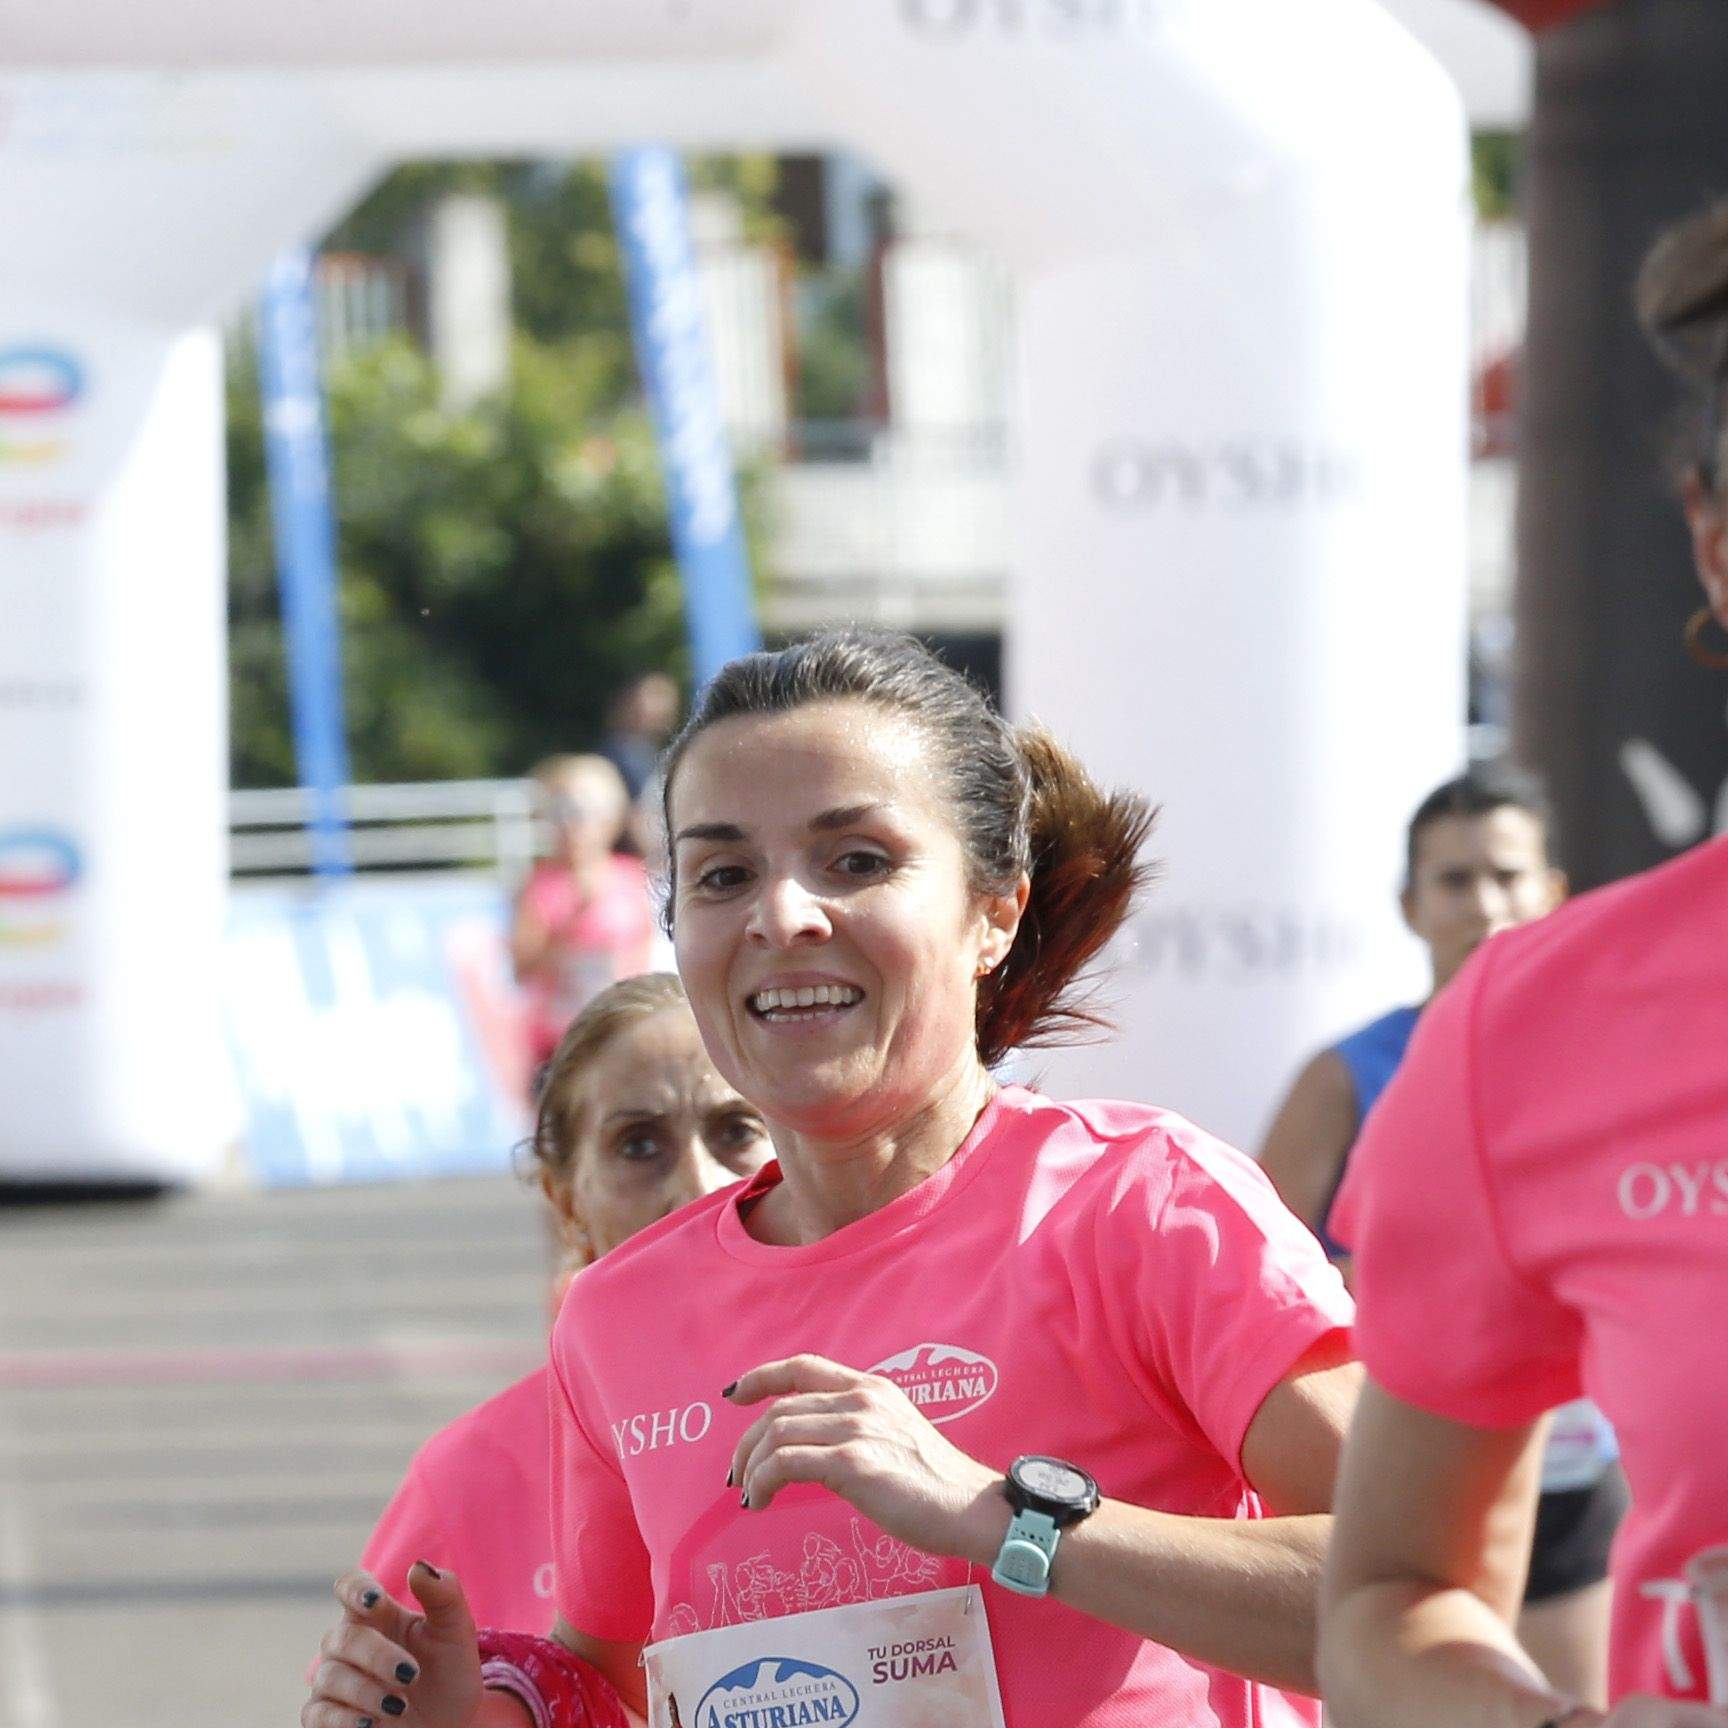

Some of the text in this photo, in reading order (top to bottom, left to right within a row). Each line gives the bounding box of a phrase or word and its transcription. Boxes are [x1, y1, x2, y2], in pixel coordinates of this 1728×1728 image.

[1090, 436, 1366, 516] OYSH
[894, 1365, 984, 1384] NTRAL LECHERA
[900, 1376, 988, 1405] URIANA
[610, 1401, 713, 1460] YSHO
[867, 1636, 956, 1660] TU DORSAL
[873, 1651, 958, 1684] SUMA
[723, 1681, 837, 1709] CENTRAL LECHERA
